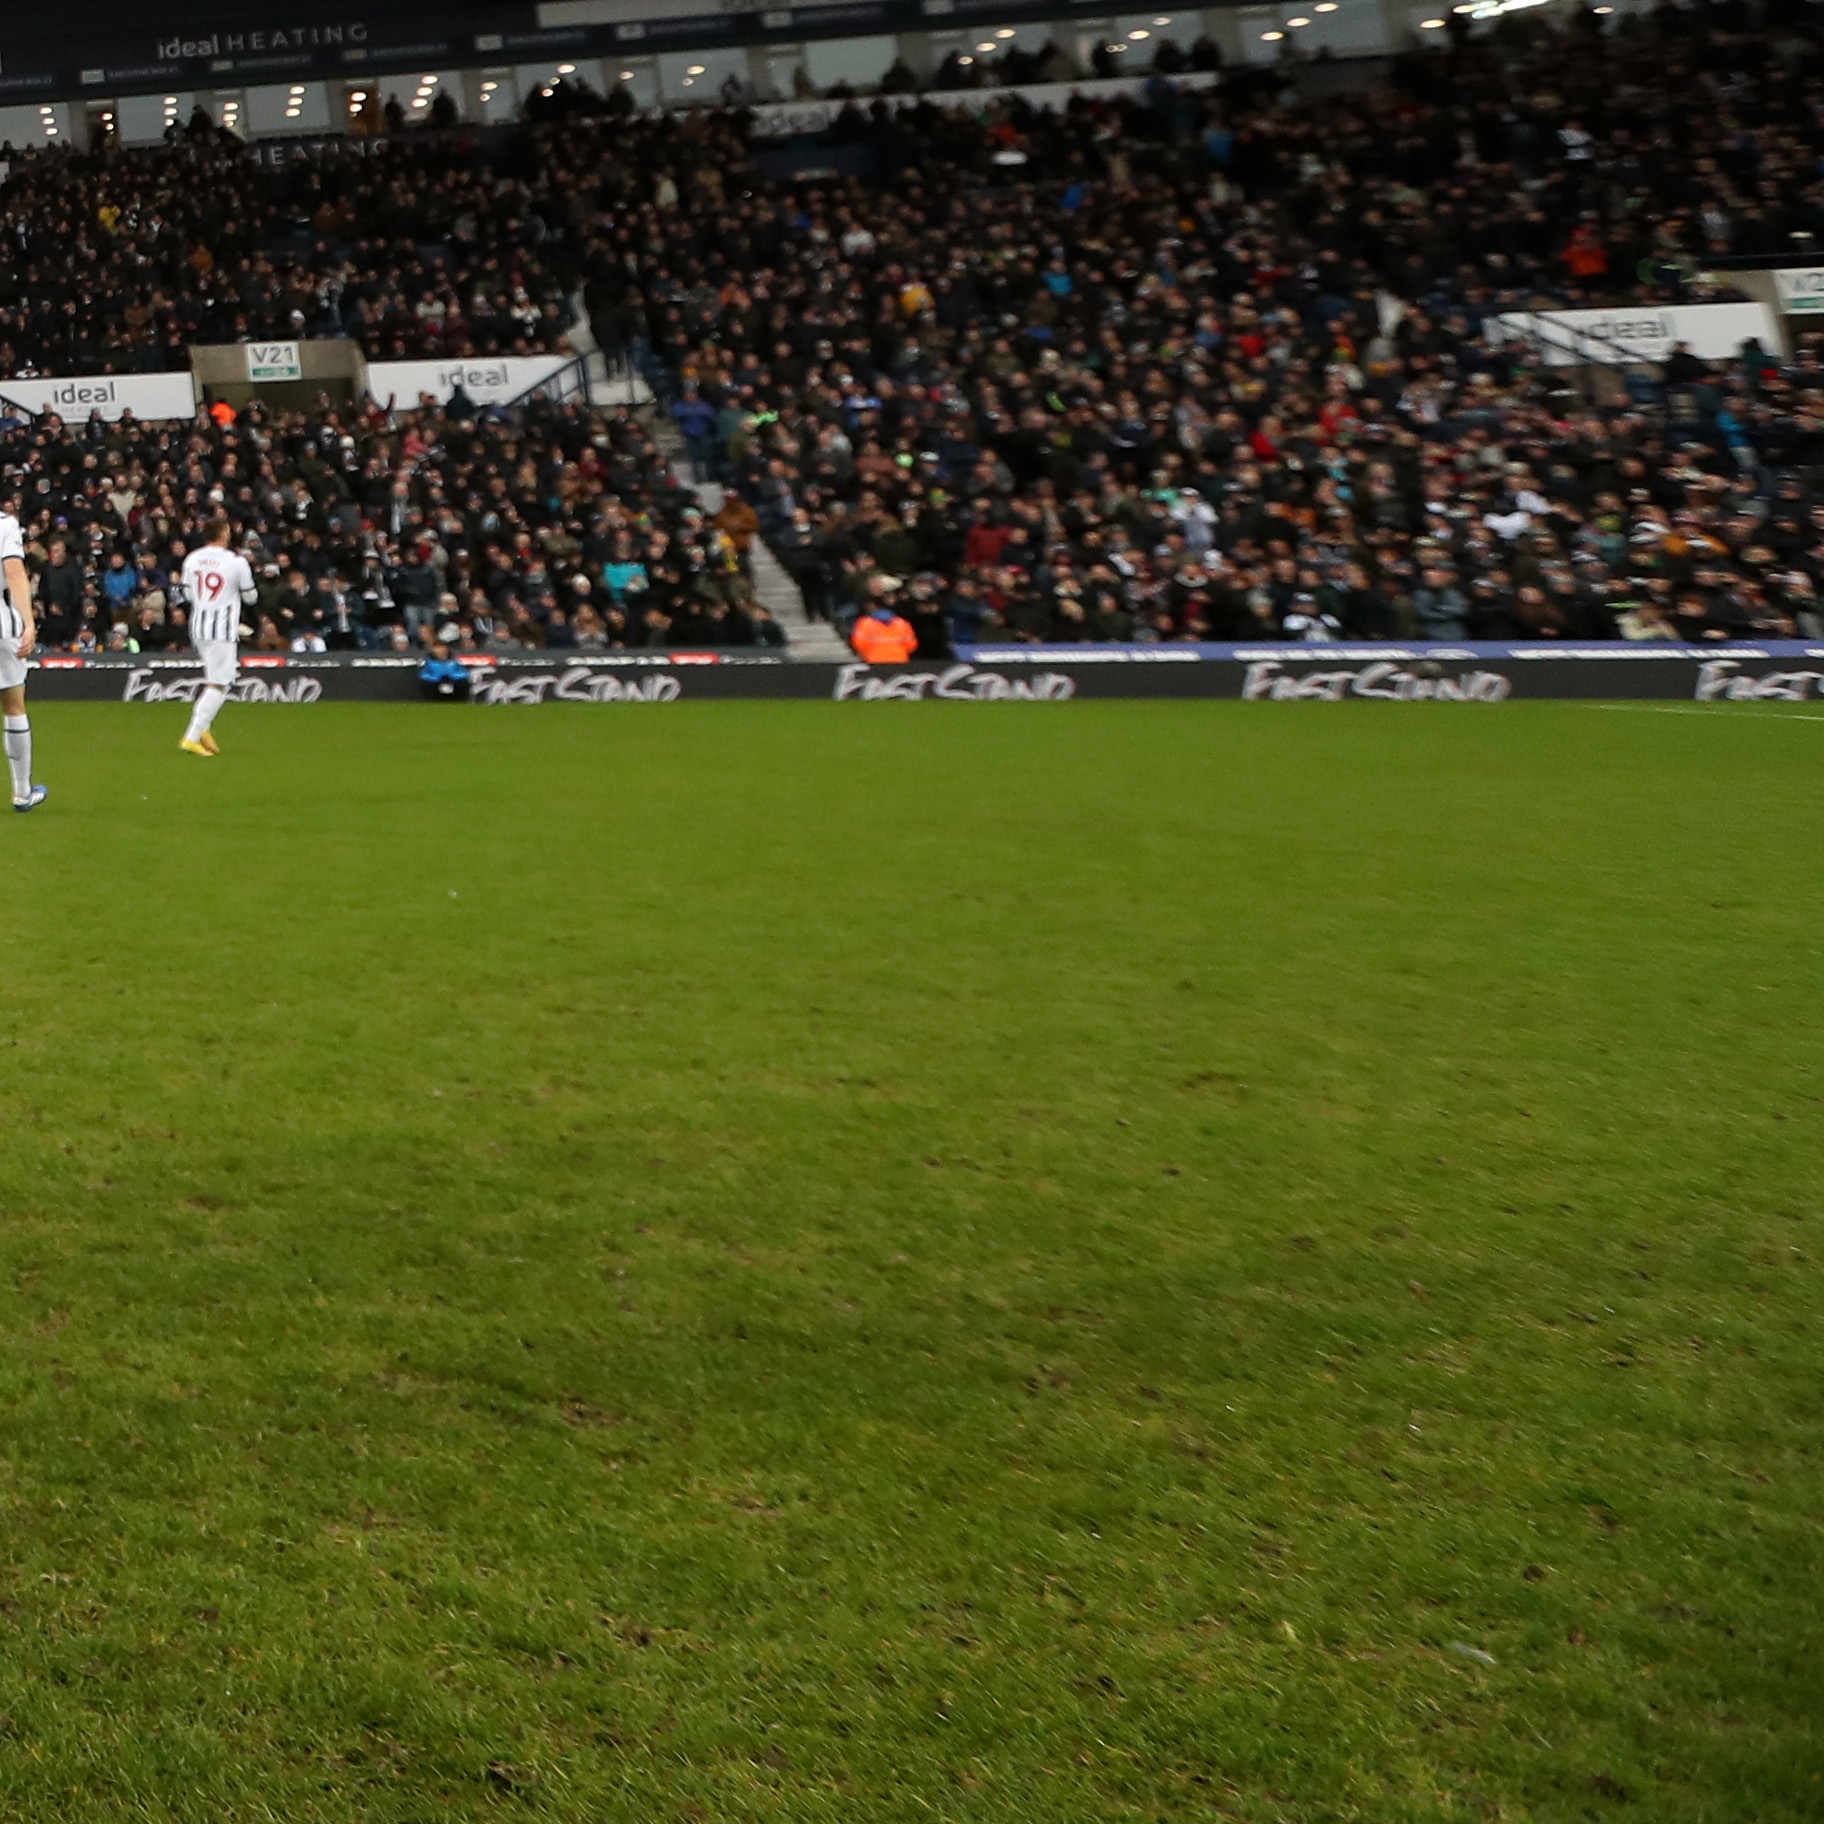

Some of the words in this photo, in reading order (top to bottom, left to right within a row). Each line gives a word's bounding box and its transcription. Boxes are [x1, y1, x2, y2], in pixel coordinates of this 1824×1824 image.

[158, 34, 220, 59] ideal
[227, 22, 368, 52] HEATING
[253, 346, 293, 365] V21
[440, 364, 510, 386] ideal
[53, 382, 116, 405] ideal
[194, 570, 225, 602] 19
[554, 666, 681, 703] STAND
[933, 663, 1077, 701] STAND
